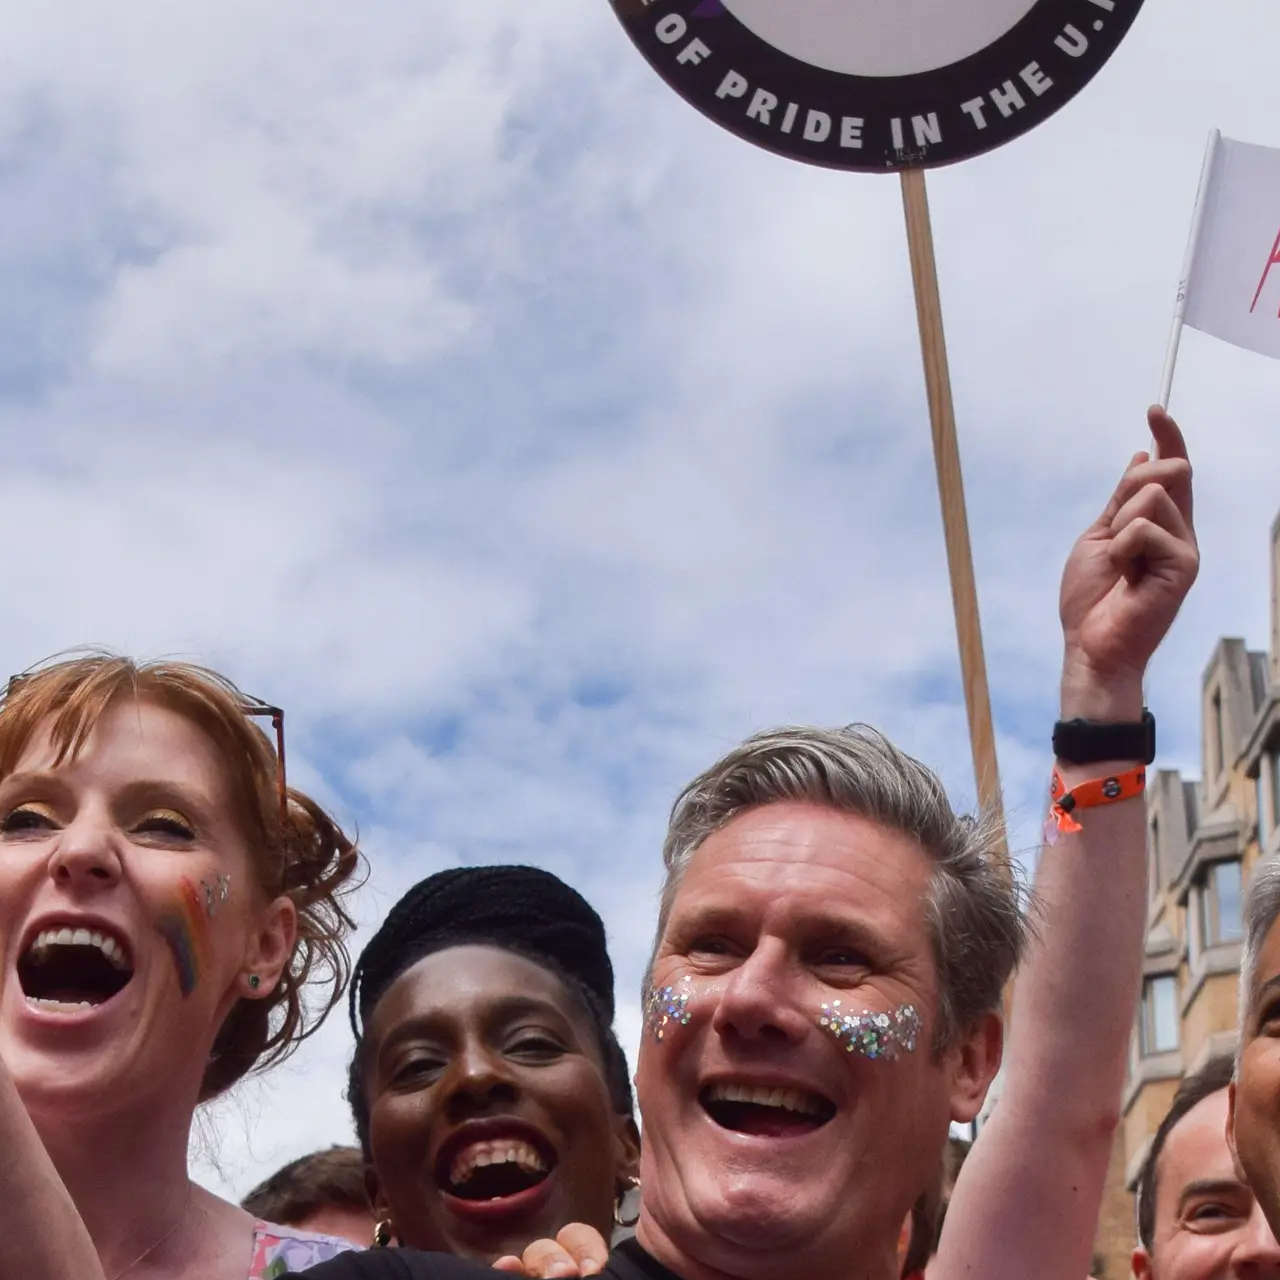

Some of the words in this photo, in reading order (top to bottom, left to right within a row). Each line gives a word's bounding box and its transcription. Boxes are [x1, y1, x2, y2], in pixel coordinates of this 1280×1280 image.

[655, 13, 713, 66] OF
[714, 69, 865, 149] PRIDE
[889, 115, 943, 150] IN
[960, 60, 1054, 131] THE
